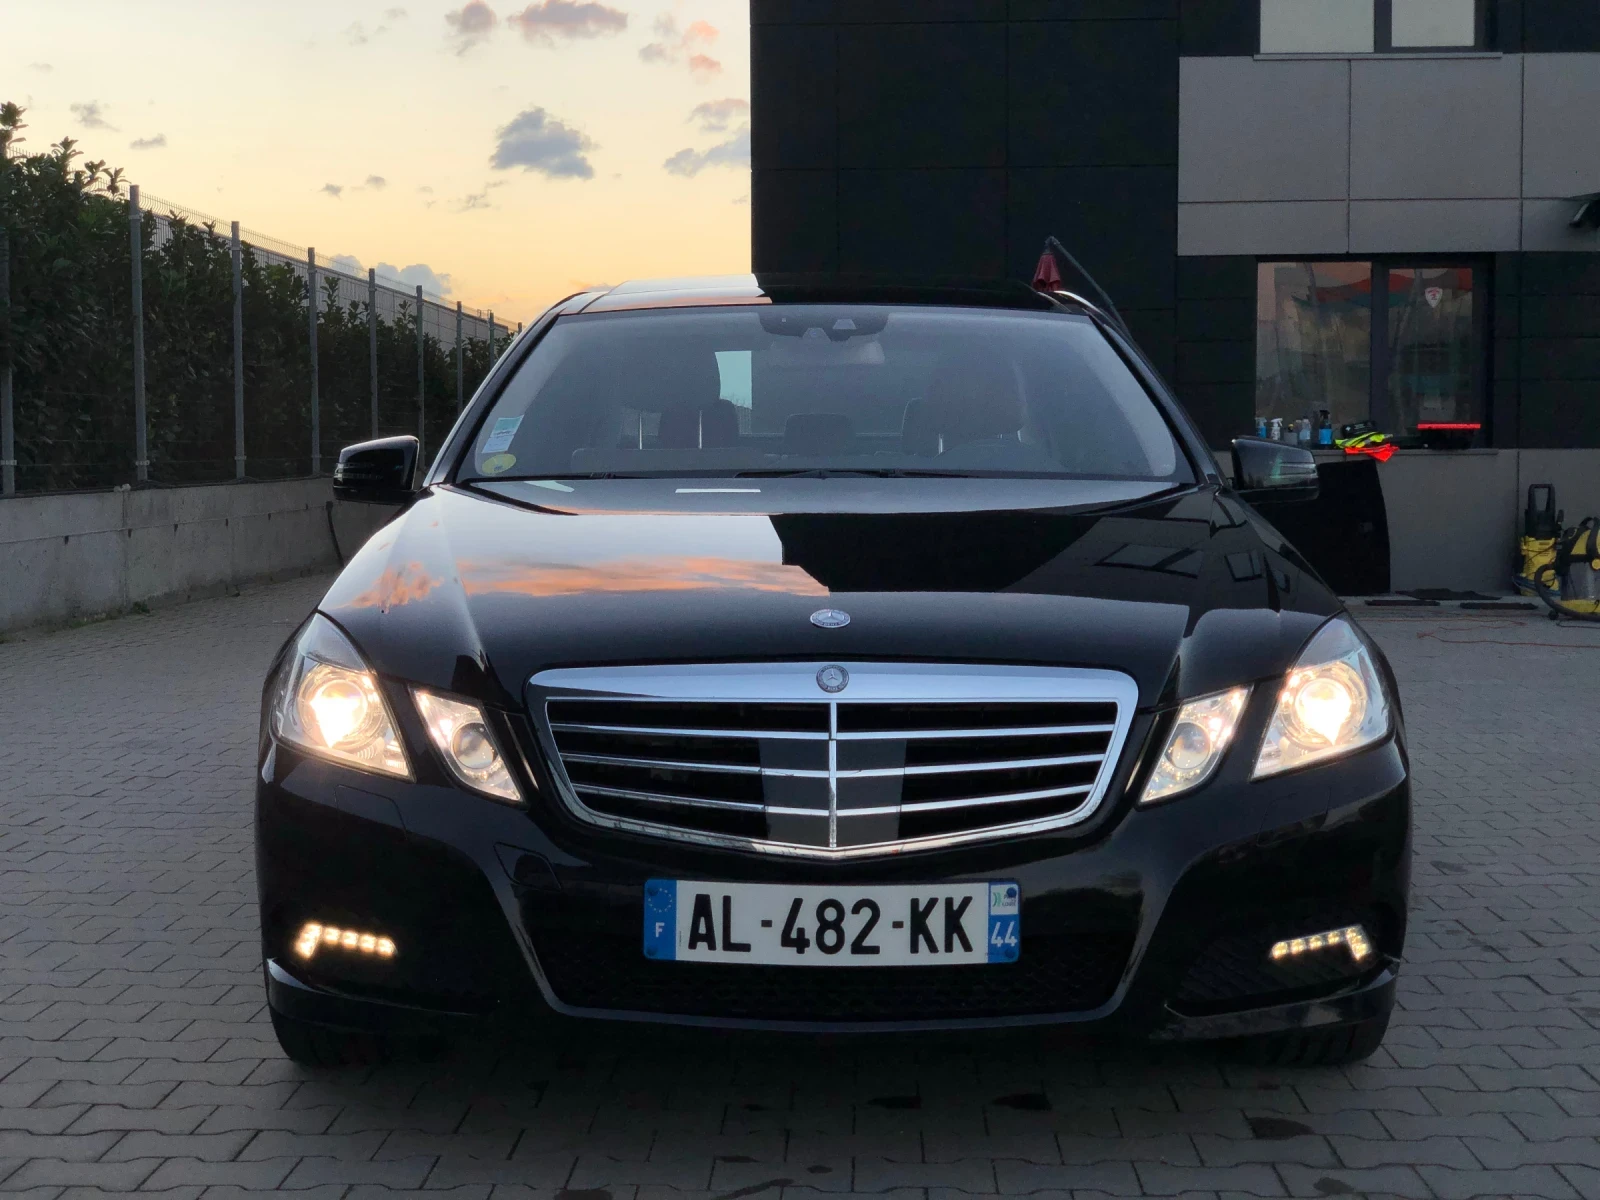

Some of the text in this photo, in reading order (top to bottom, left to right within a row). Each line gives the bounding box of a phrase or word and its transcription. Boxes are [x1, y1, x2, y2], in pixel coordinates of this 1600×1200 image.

[655, 921, 665, 938] F
[688, 893, 973, 955] AL-482-KK
[990, 921, 1018, 948] 44
